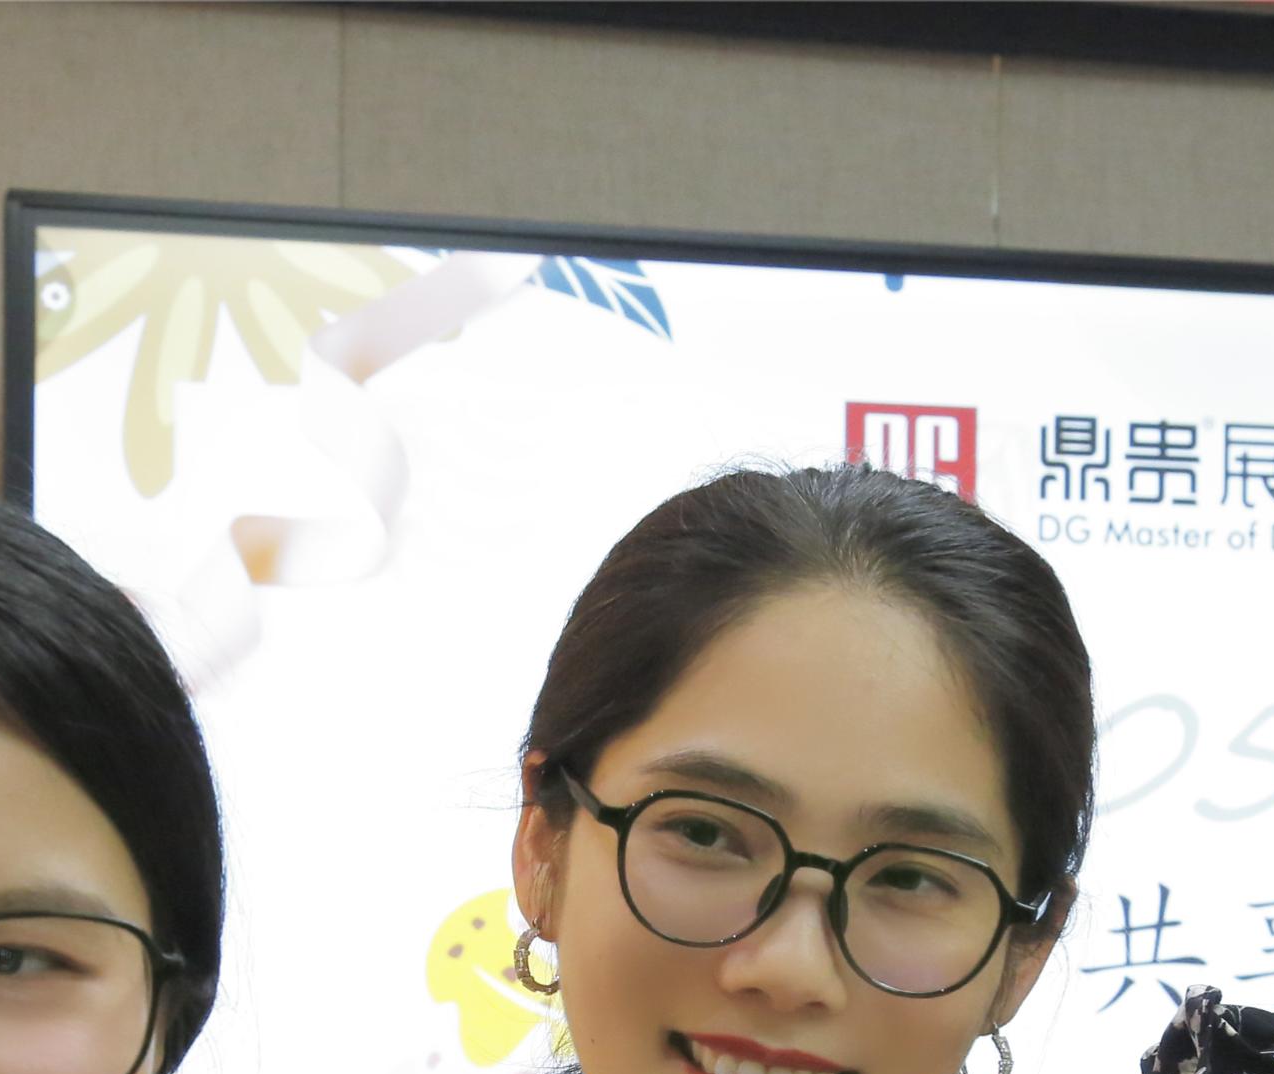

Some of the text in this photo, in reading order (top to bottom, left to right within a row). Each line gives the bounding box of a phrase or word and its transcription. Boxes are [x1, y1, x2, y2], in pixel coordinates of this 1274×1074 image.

[1038, 513, 1091, 545] DG
[1104, 519, 1213, 549] Master
[1227, 520, 1258, 551] of
